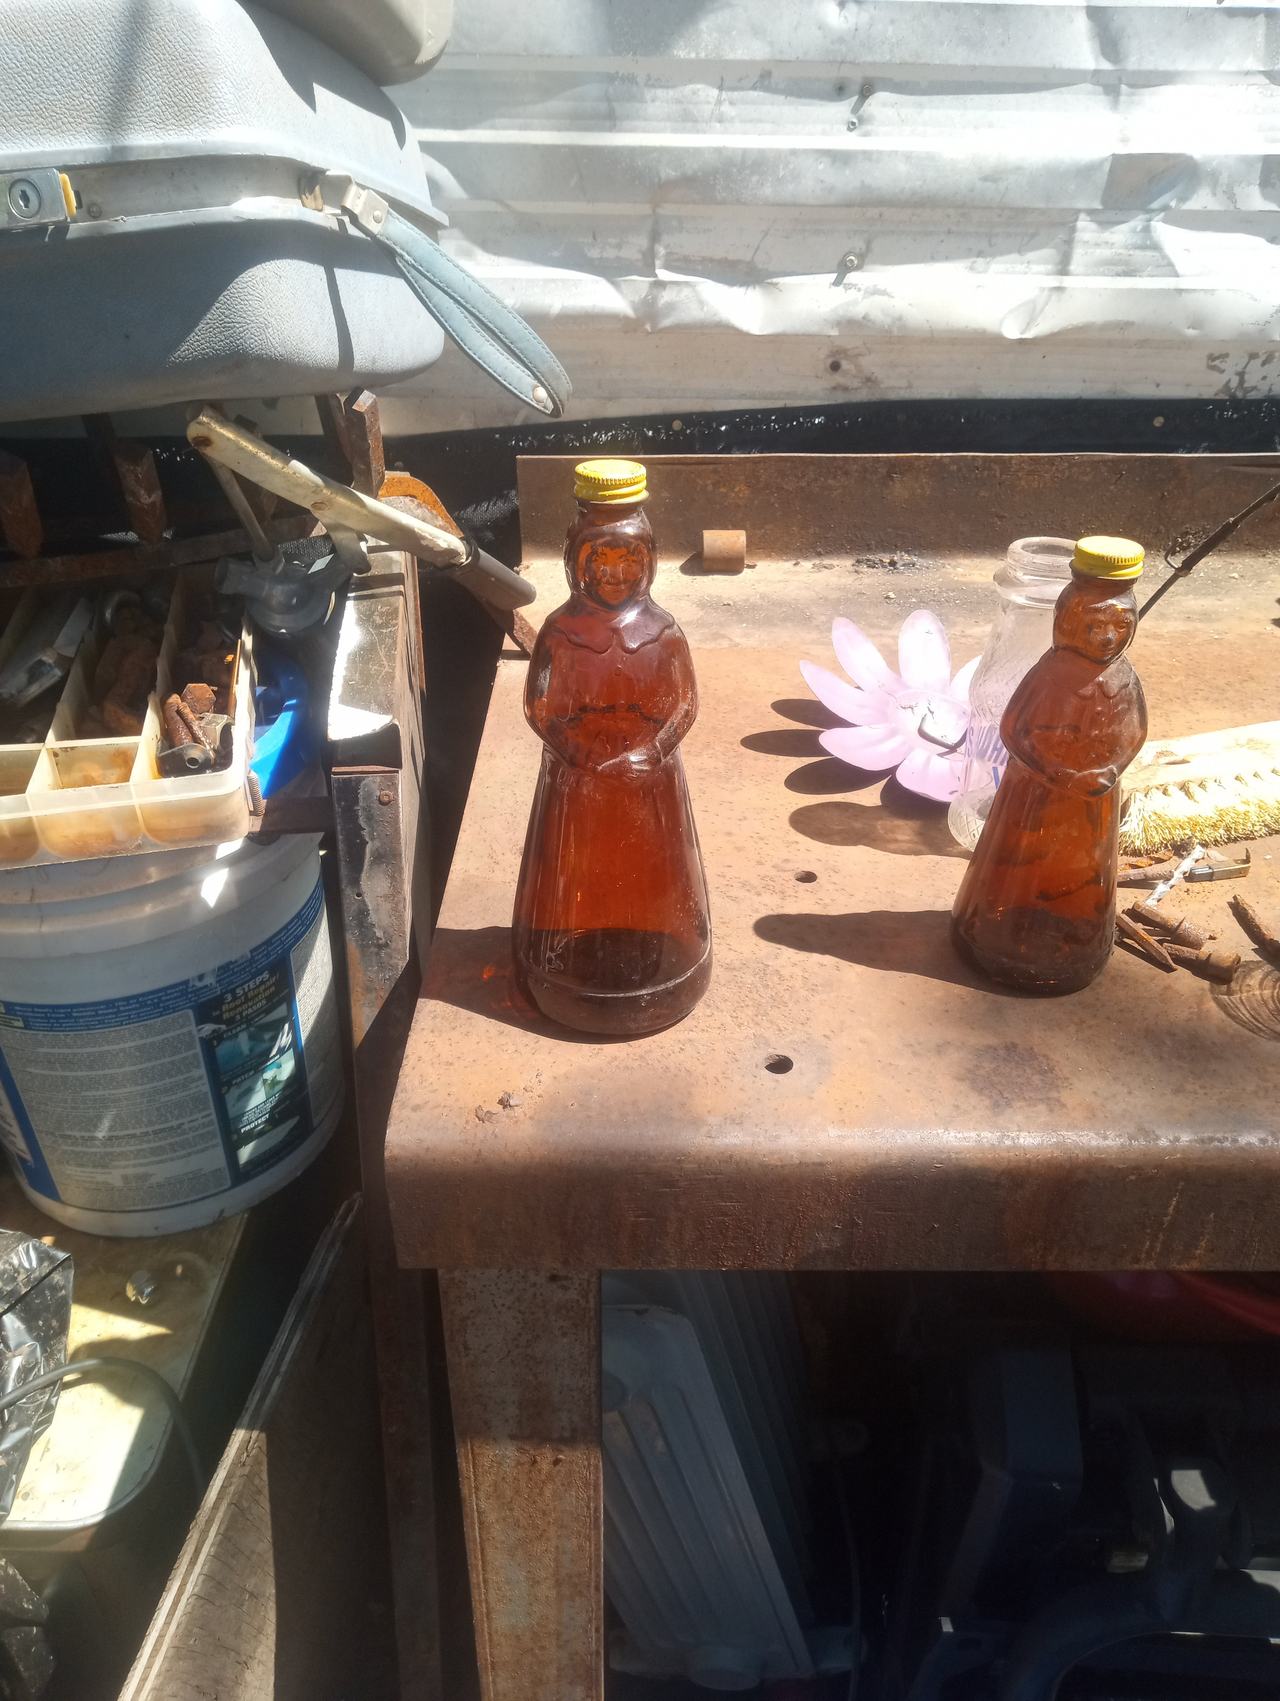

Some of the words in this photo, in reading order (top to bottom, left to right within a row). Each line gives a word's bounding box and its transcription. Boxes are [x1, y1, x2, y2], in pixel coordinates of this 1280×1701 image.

[223, 992, 233, 1003] 3
[235, 970, 271, 997] STEPS
[239, 1113, 271, 1134] PROTECT
